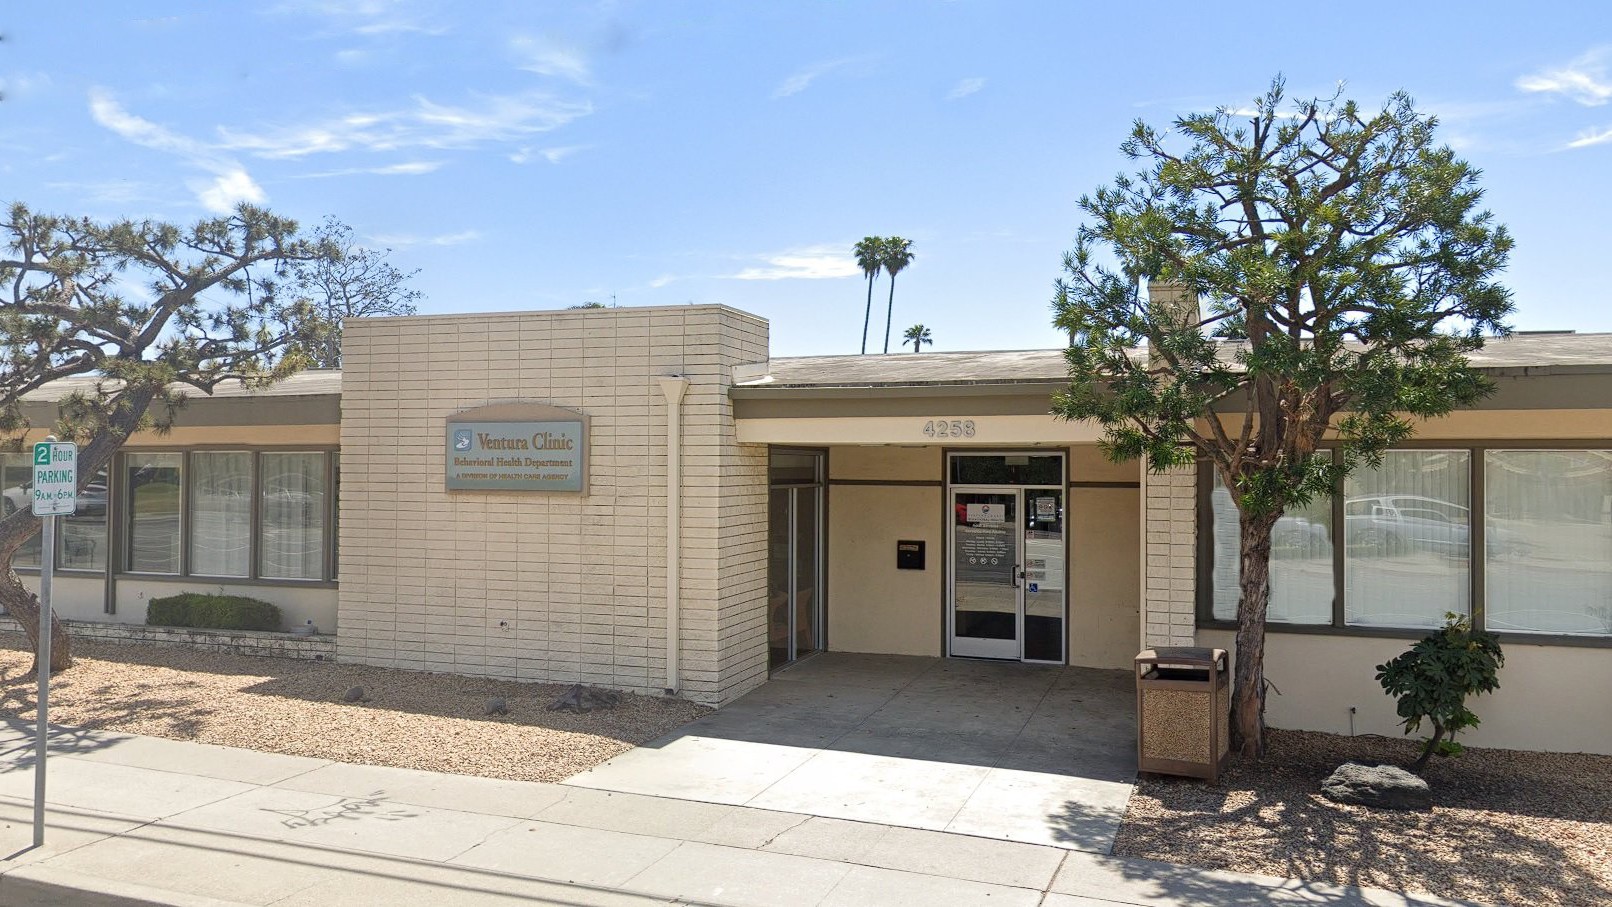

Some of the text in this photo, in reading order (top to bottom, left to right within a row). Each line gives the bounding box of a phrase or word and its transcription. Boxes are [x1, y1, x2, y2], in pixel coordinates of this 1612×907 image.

[923, 420, 976, 438] 4258
[477, 431, 573, 451] Ventura Clinic
[37, 446, 73, 462] 2 HOUR
[454, 456, 573, 469] Behavioral Health Department
[37, 470, 73, 484] PARKING
